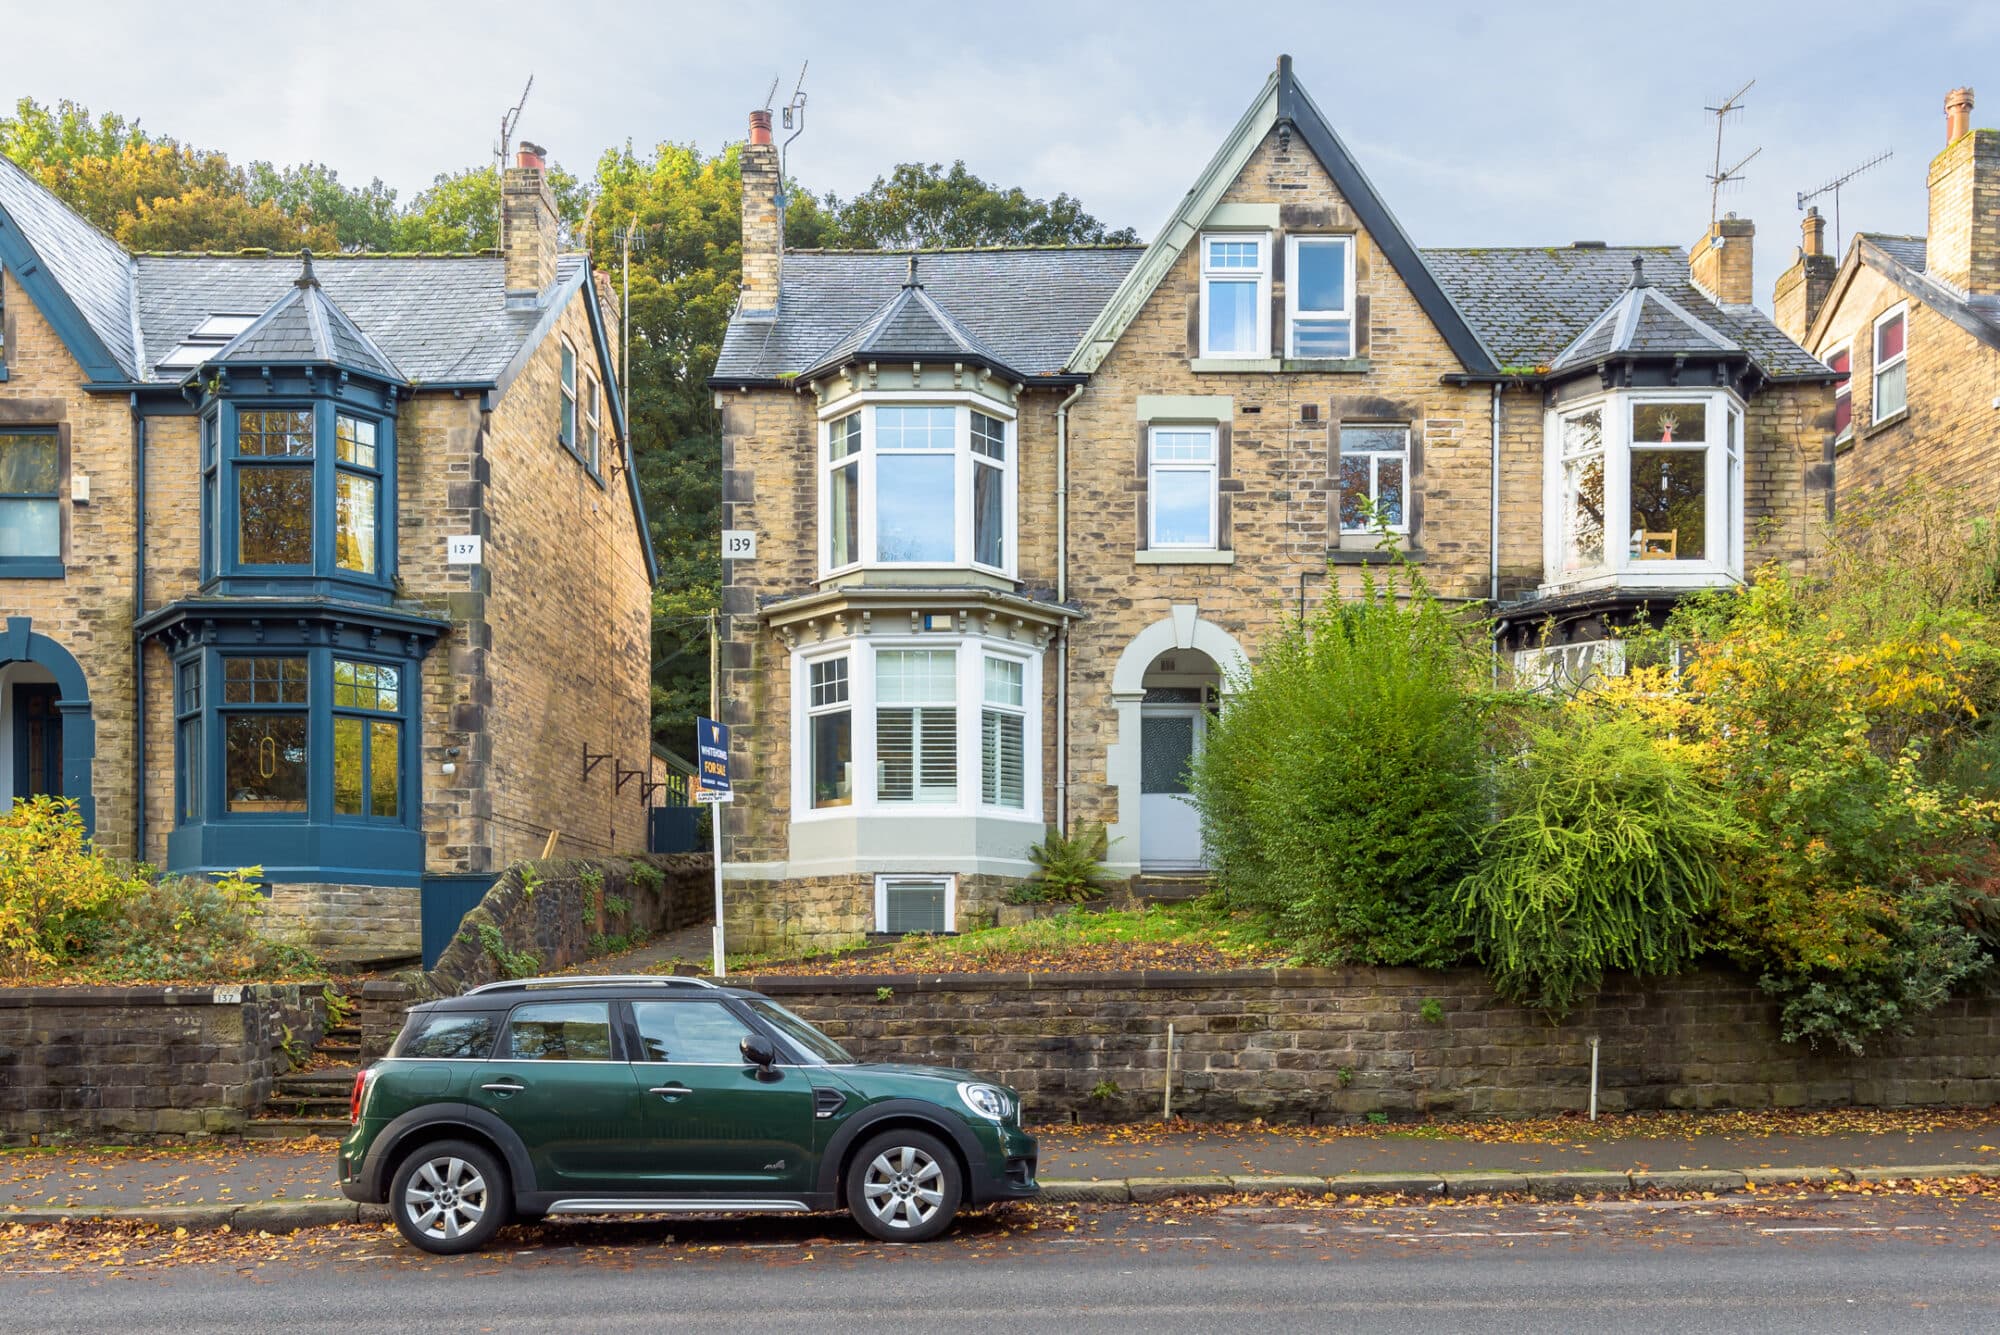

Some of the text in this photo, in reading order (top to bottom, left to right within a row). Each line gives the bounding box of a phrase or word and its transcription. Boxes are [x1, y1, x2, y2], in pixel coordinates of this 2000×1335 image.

[454, 544, 474, 554] 137
[729, 538, 750, 551] 139
[704, 761, 716, 774] FOR
[218, 994, 234, 1003] 137
